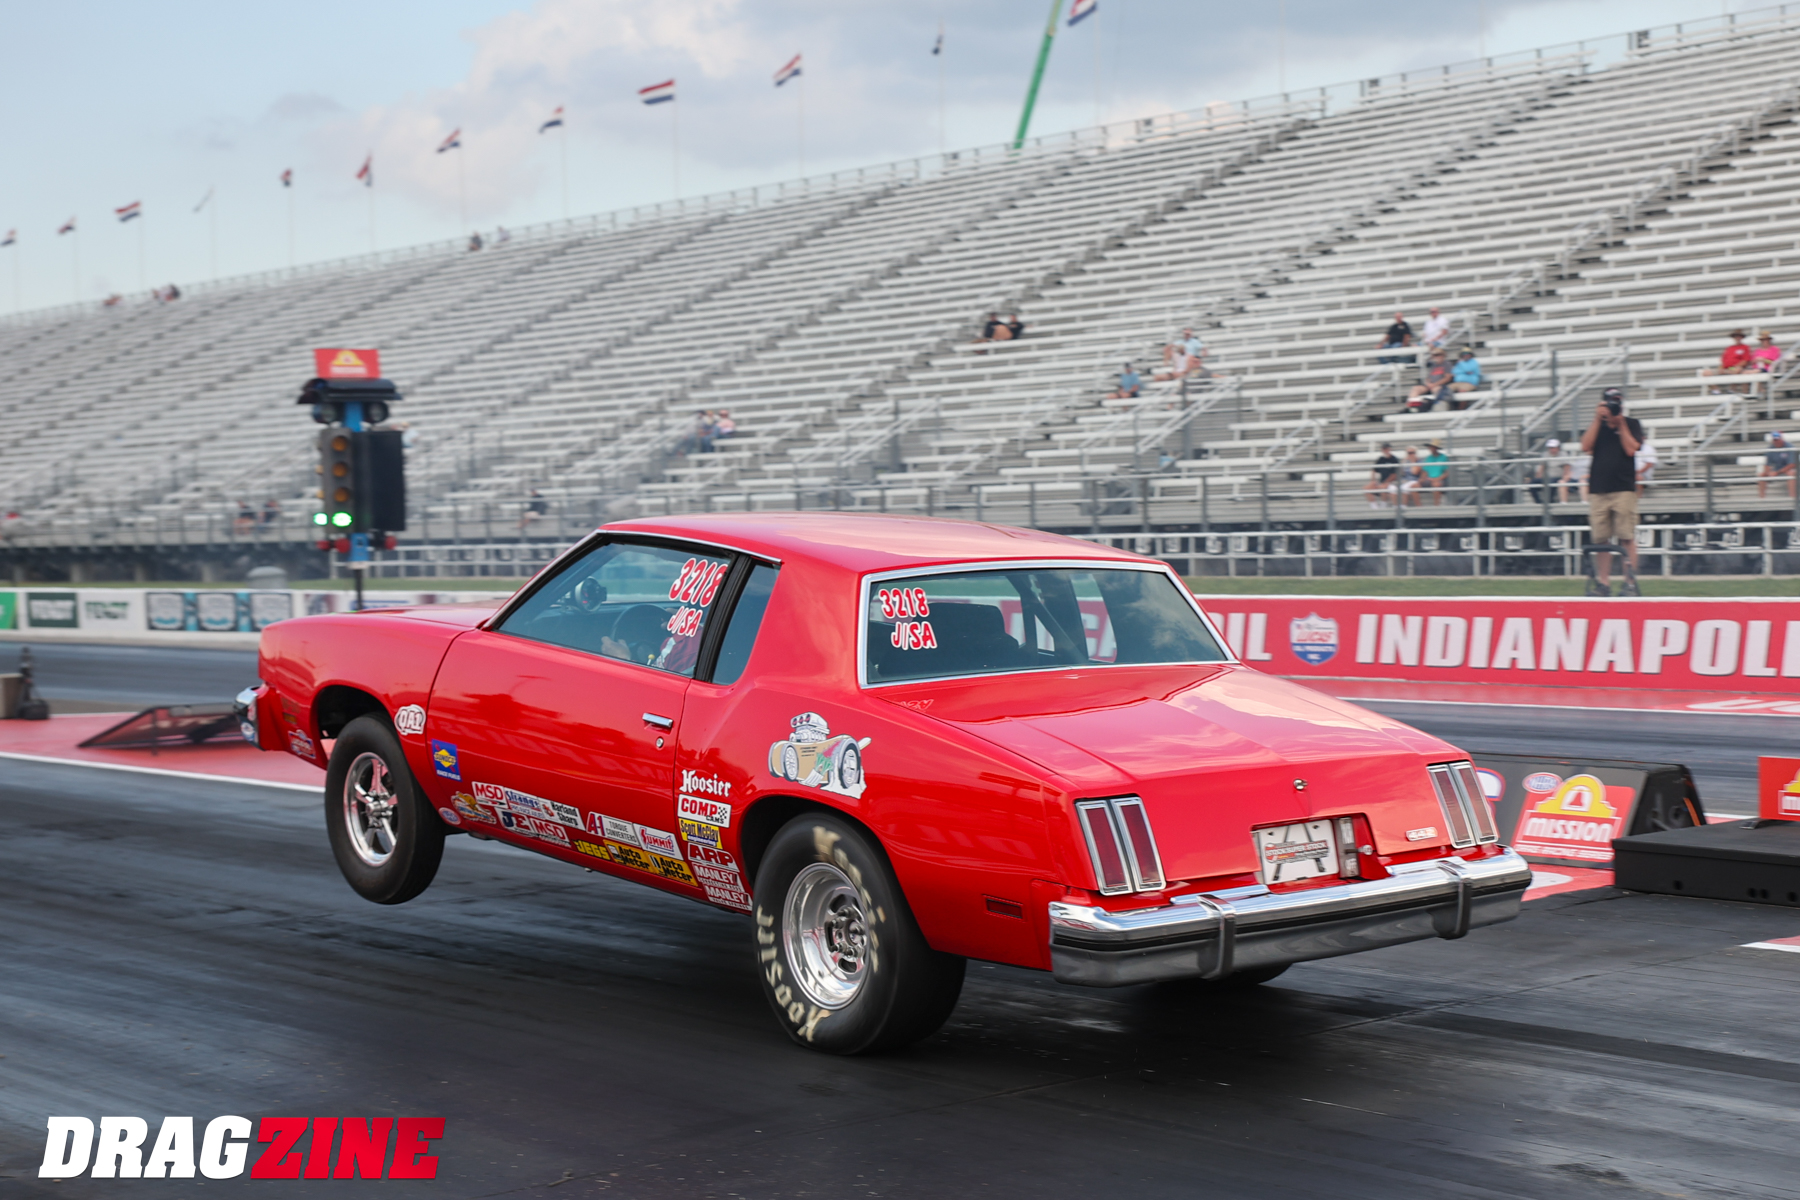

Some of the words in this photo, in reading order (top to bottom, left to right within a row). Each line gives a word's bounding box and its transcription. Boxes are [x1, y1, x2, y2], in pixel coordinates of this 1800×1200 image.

[669, 558, 728, 607] 3218
[879, 587, 930, 618] 3218
[475, 783, 504, 800] MSD
[679, 769, 732, 797] Hoosier
[505, 790, 540, 808] Strange
[681, 798, 717, 816] COMP
[502, 811, 531, 831] JE
[609, 821, 628, 833] TORQUE
[706, 815, 724, 824] CAMS
[533, 820, 566, 840] MSD
[605, 827, 636, 843] CONVERTERS
[1524, 818, 1613, 842] MISSION
[576, 840, 611, 860] JEGS
[619, 843, 641, 859] Auto
[690, 844, 734, 866] ARP
[623, 855, 650, 870] Meter
[660, 858, 684, 871] Auto
[662, 867, 693, 882] Meter
[694, 865, 734, 884] MANLEY
[705, 886, 745, 904] MANLEY
